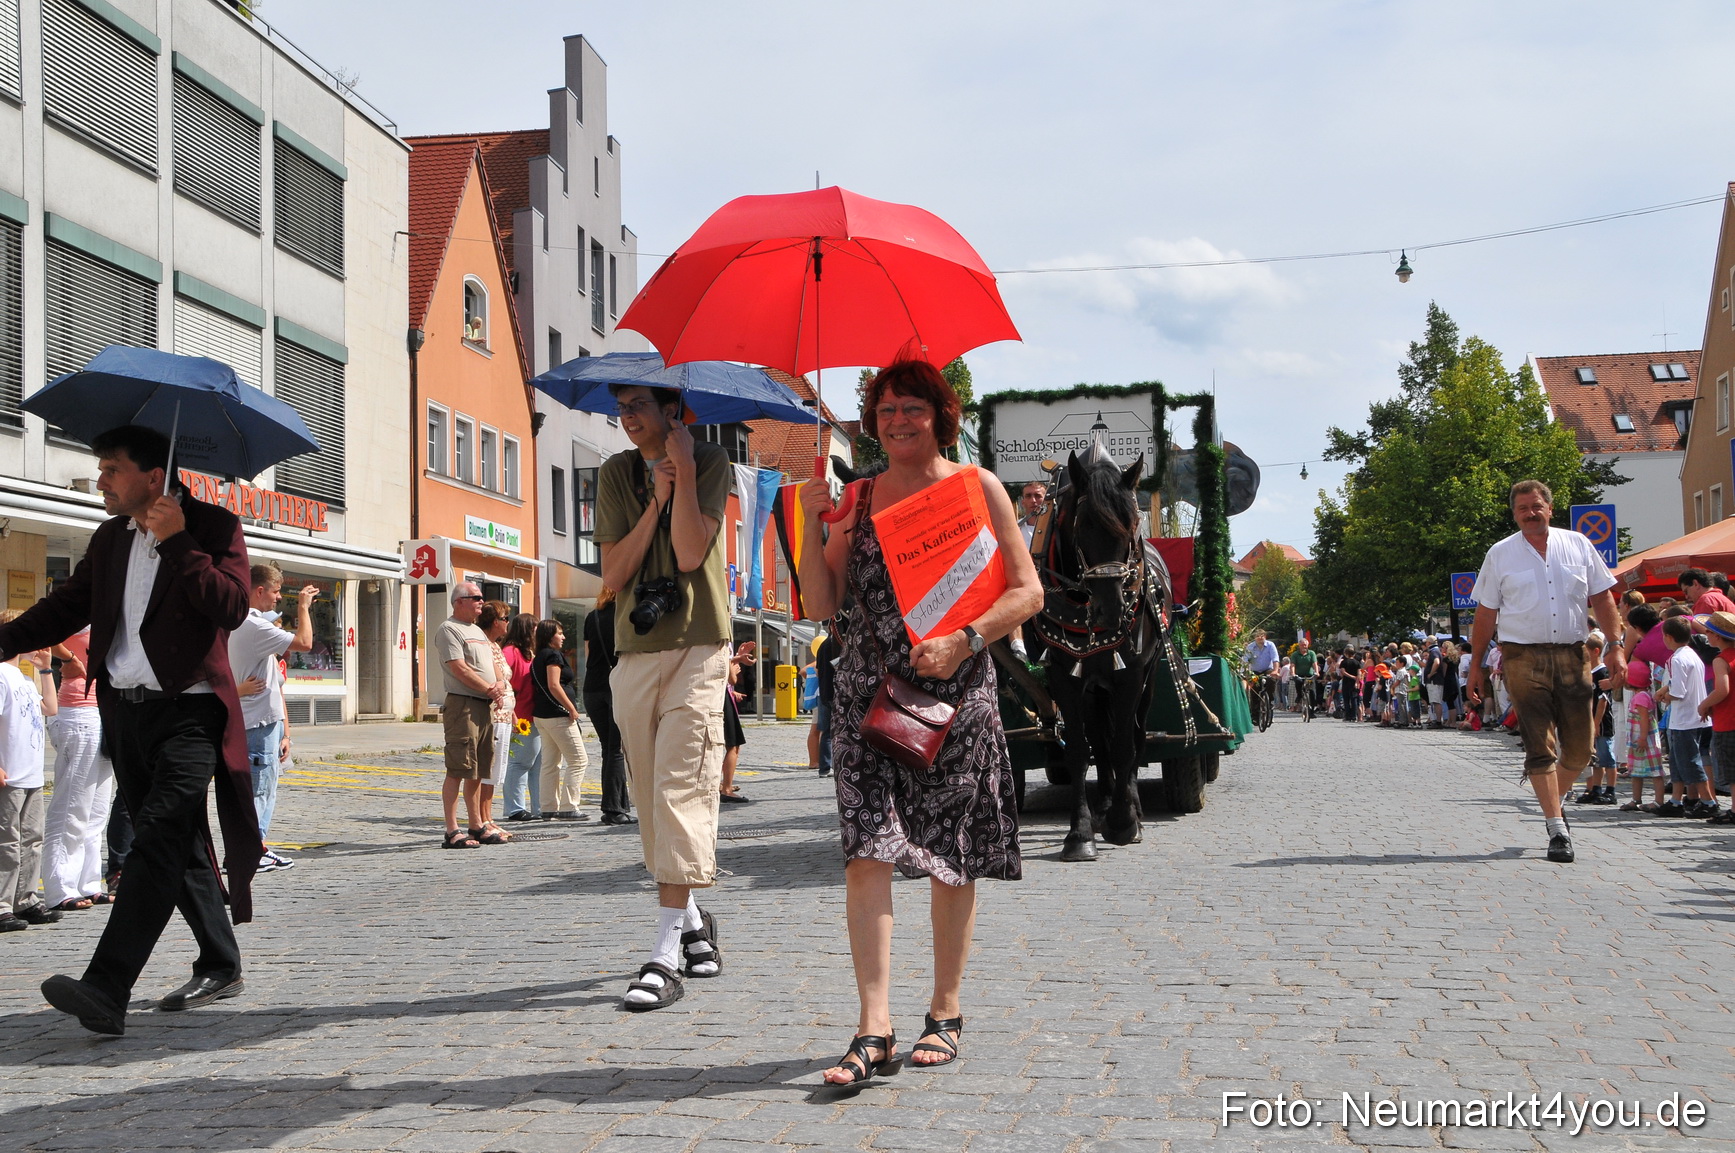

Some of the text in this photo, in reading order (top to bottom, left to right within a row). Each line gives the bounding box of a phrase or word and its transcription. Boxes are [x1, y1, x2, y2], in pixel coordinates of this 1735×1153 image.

[996, 437, 1089, 454] Schloßspiele
[1000, 452, 1047, 463] Neumark
[468, 521, 487, 539] Blumen
[896, 546, 921, 566] Das
[922, 514, 983, 554] Kaffeehaus
[1597, 549, 1612, 563] XI
